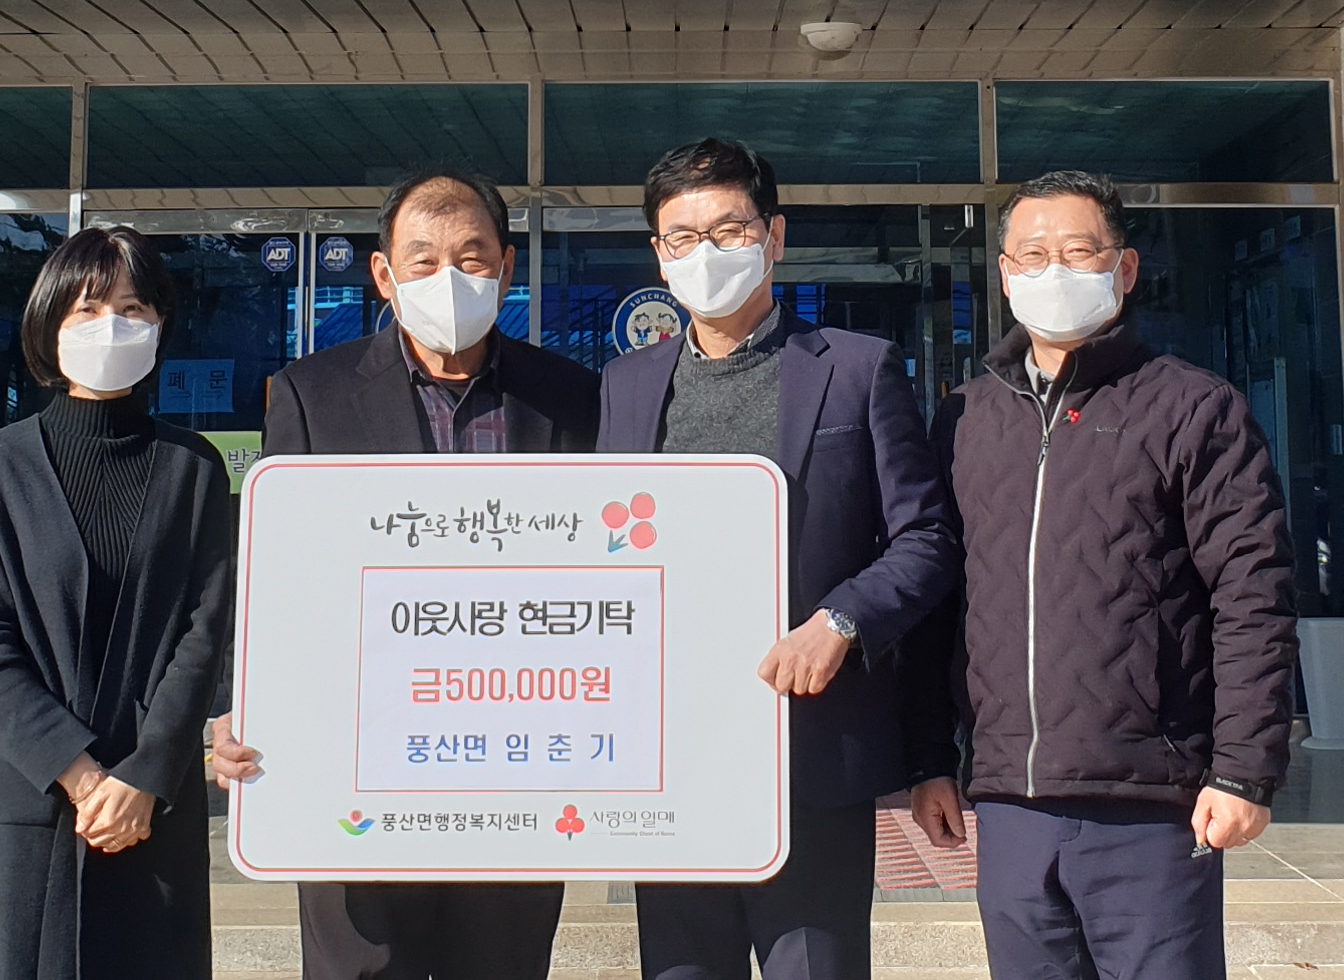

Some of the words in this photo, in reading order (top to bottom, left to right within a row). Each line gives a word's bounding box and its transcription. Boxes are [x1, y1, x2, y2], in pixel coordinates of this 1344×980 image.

[266, 248, 291, 261] ADT
[324, 248, 349, 261] ADT
[630, 293, 677, 308] SUNCHANG
[370, 500, 450, 548] 나눔으로
[453, 498, 524, 553] 행복한
[527, 512, 584, 543] 세상
[391, 600, 509, 637] 이웃사랑
[518, 600, 636, 636] 현금기탁
[411, 666, 611, 704] 금500,000원
[406, 733, 488, 764] 풍산면
[380, 812, 538, 832] 풍산면행정복지센터
